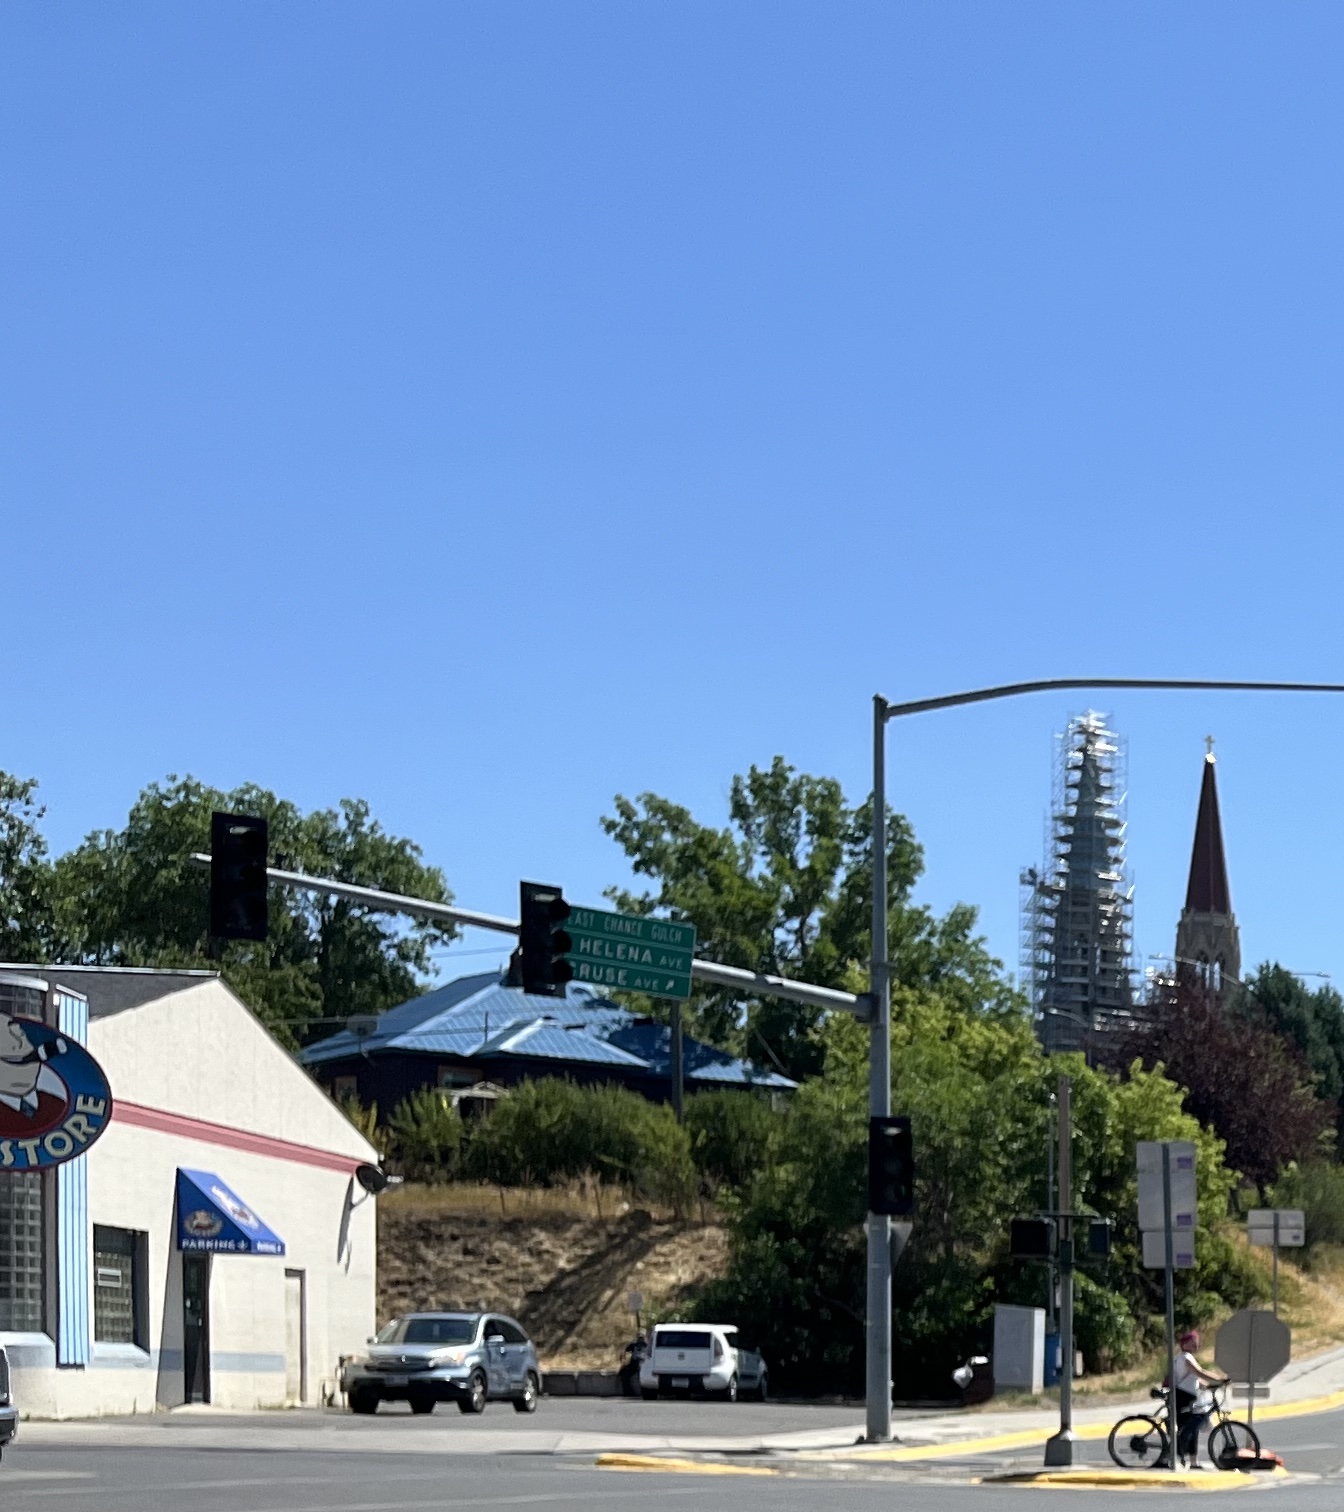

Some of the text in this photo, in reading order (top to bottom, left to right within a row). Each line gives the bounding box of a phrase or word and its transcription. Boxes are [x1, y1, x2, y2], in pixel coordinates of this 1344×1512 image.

[604, 915, 643, 938] CHANCE
[651, 924, 683, 943] GULCH
[579, 937, 684, 970] HELENA AVE
[634, 977, 660, 991] AVE
[0, 1094, 106, 1167] STORE
